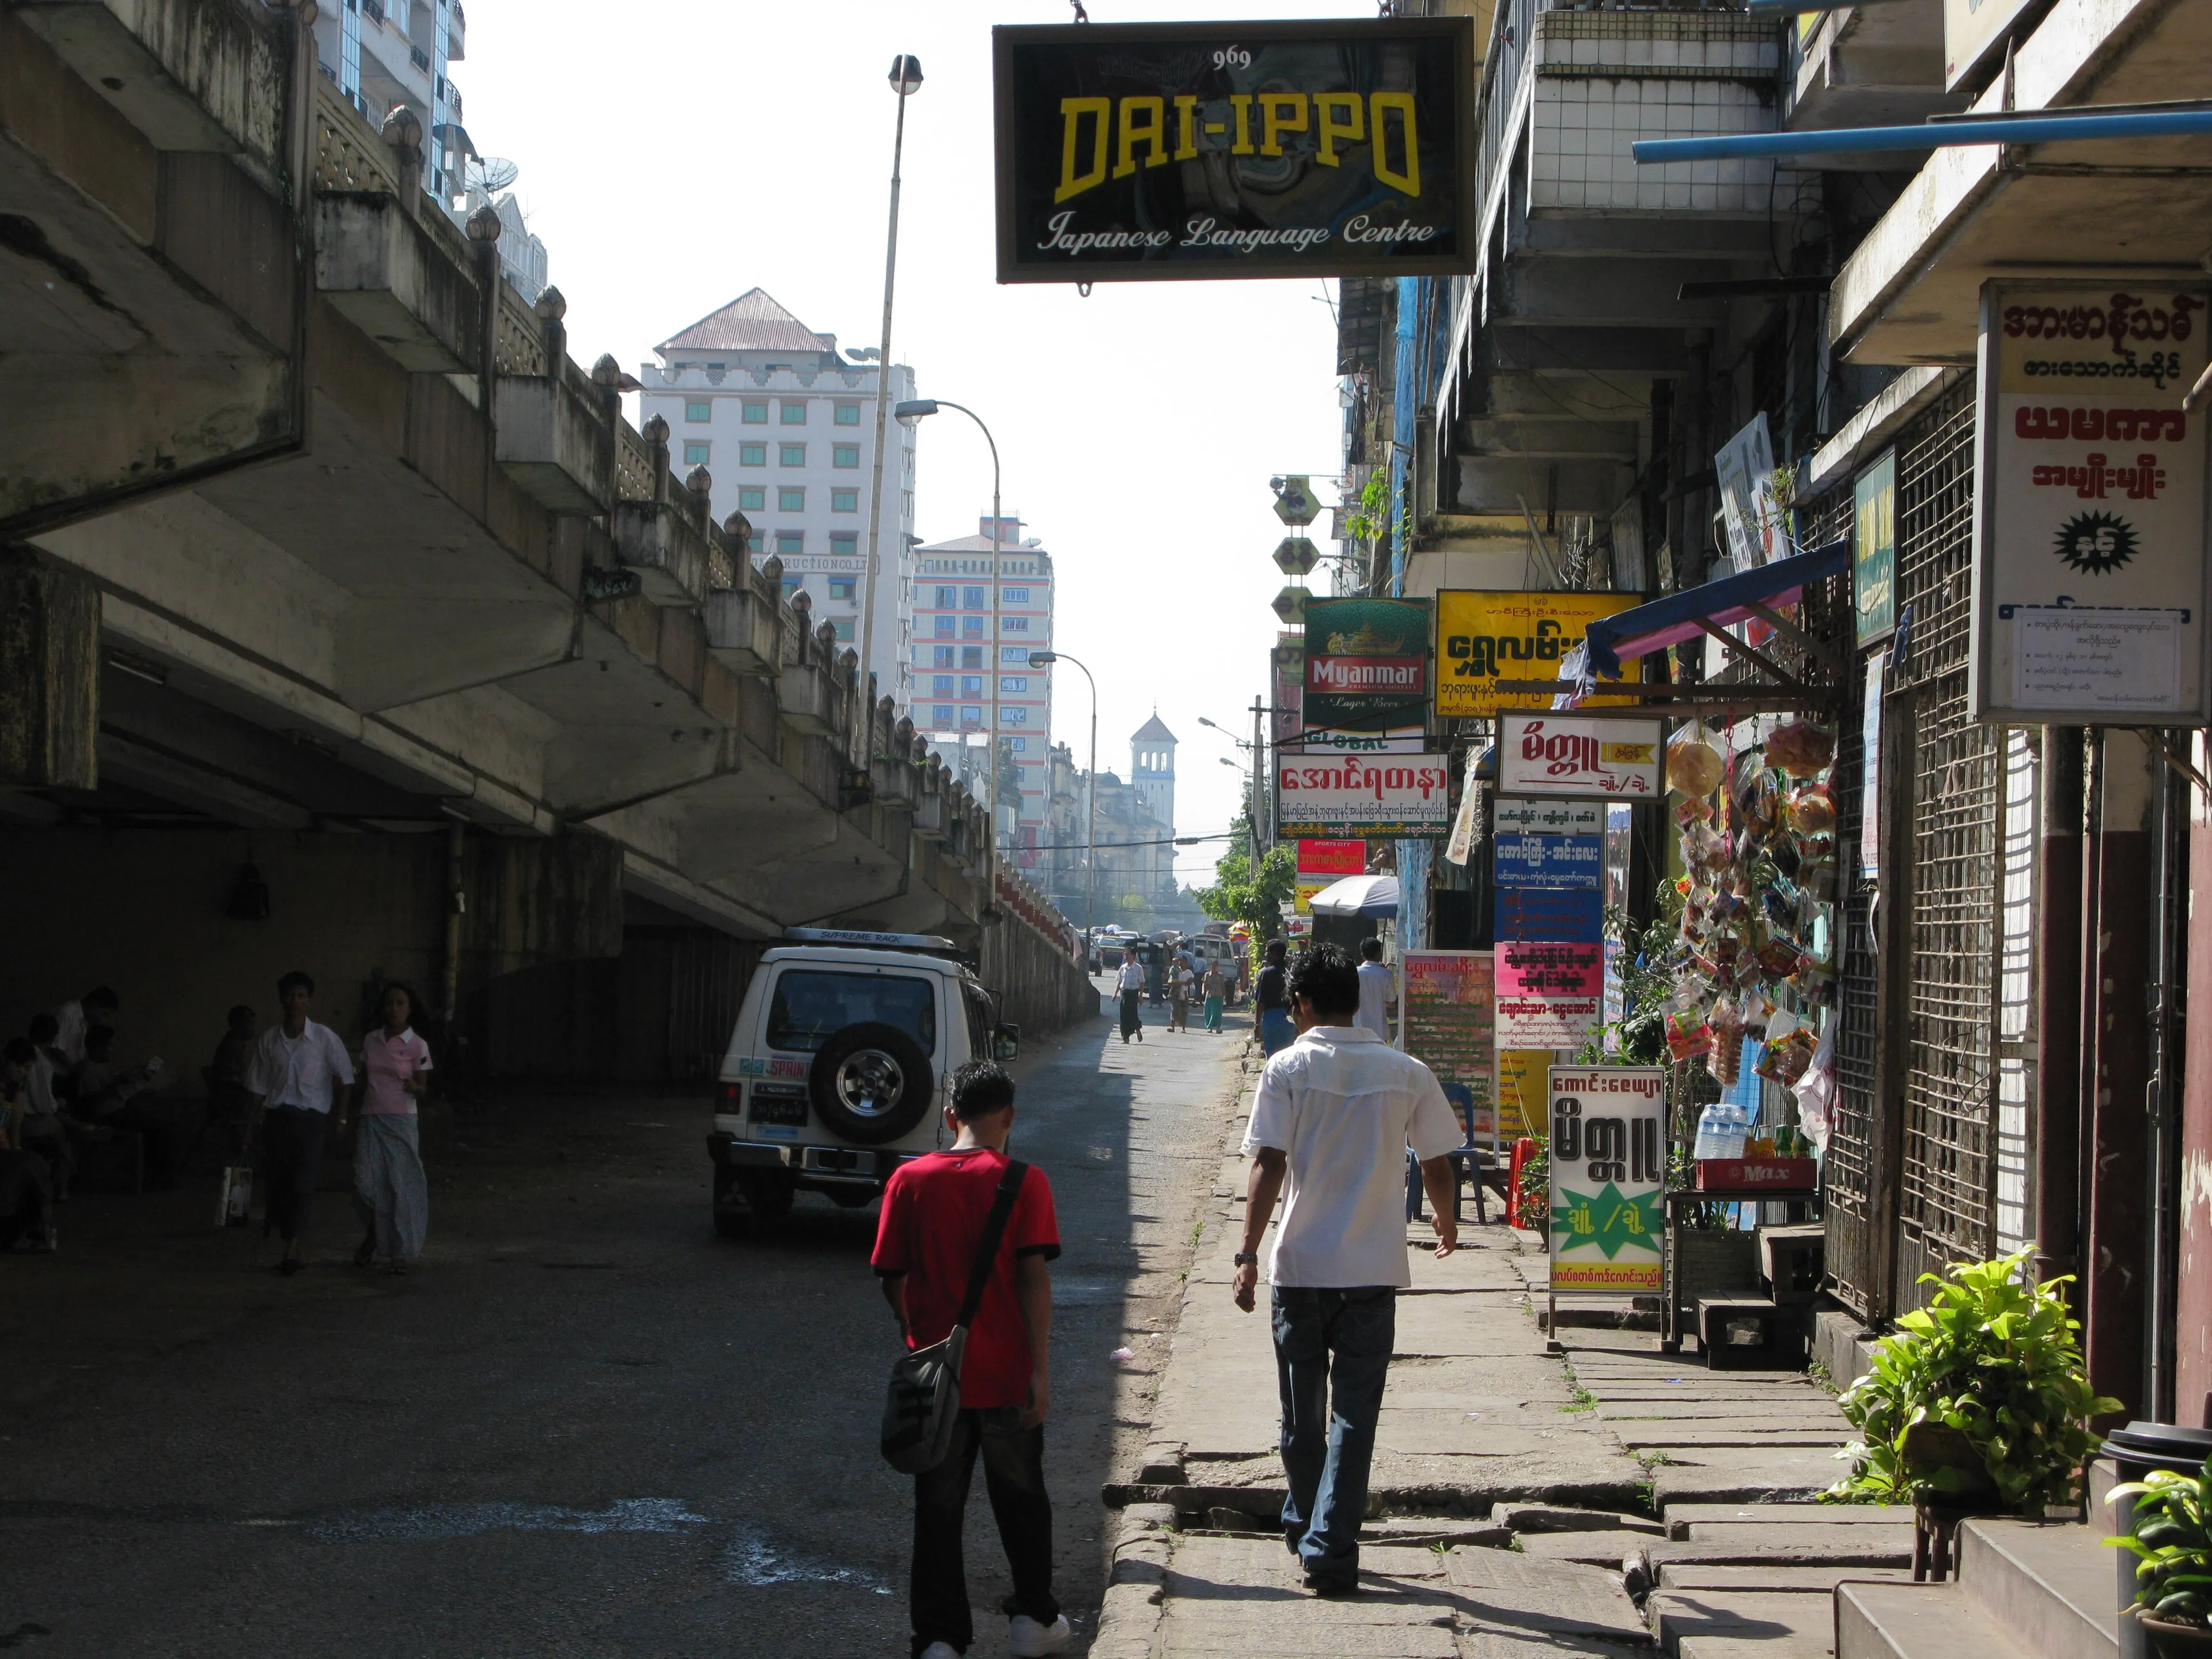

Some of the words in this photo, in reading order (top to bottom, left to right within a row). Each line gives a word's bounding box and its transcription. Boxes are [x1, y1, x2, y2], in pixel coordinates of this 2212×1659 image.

[1213, 46, 1251, 70] 969
[1055, 92, 1420, 204] DAI-IPPO
[1037, 211, 1171, 255] Japanese
[1180, 218, 1330, 253] Language
[1344, 215, 1435, 243] Centre
[2016, 407, 2185, 442] ယမကာ
[2033, 453, 2165, 499] အမျိုးမျိုး
[1313, 660, 1418, 688] Myanmar
[1331, 697, 1366, 710] Lager
[1369, 697, 1399, 708] Beer
[1306, 730, 1388, 750] GLOBAL
[1281, 756, 1446, 800] အောင်ရတနာ
[820, 931, 872, 942] SUPREME
[874, 933, 902, 944] RACK
[1555, 1098, 1659, 1182] မိတ္တူ
[1743, 1165, 1790, 1183] Max
